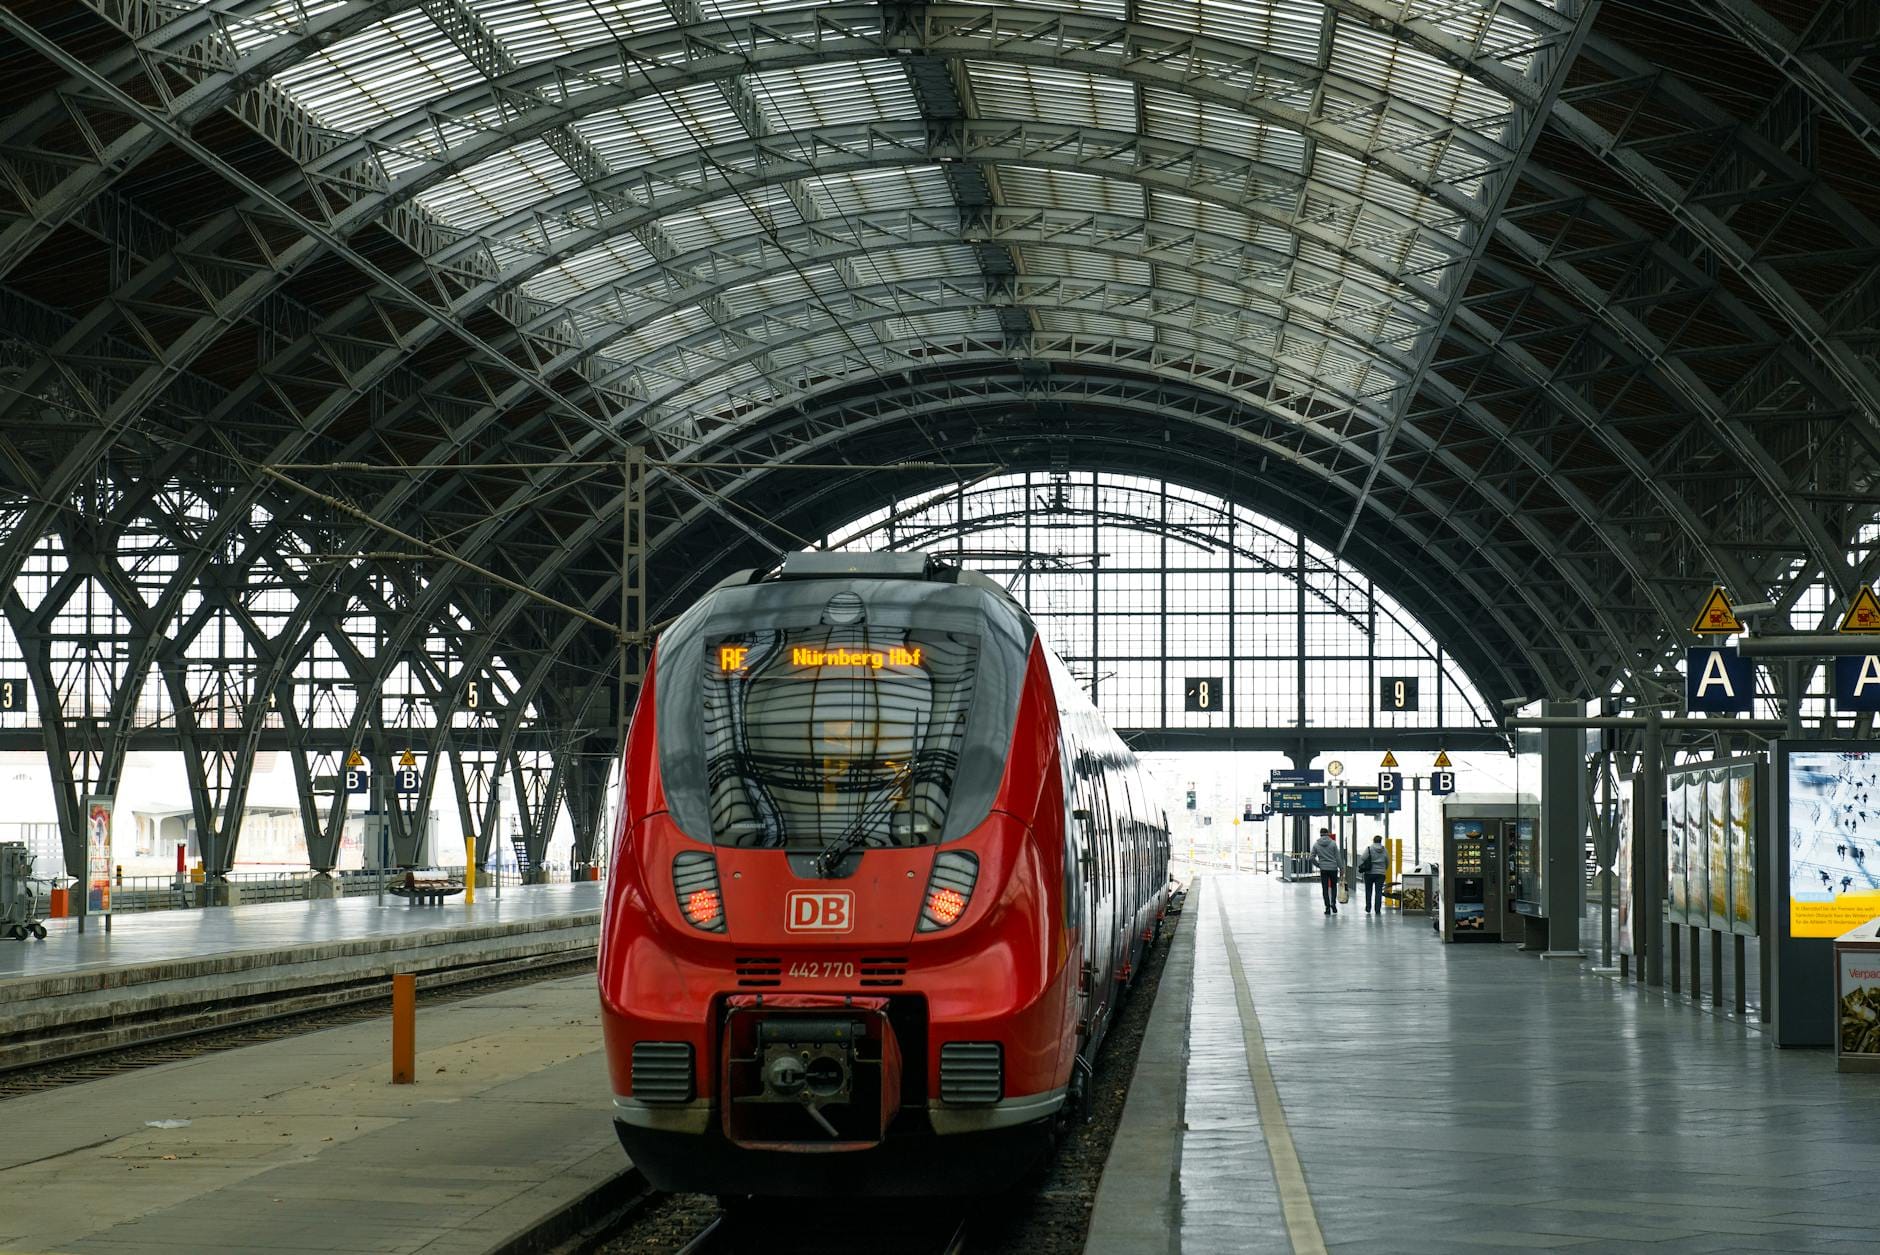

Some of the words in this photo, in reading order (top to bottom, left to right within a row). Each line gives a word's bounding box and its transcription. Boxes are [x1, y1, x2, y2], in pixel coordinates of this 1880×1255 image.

[721, 649, 748, 670] RE
[793, 648, 883, 668] Nürnberg
[889, 648, 920, 666] Hbf
[1696, 651, 1735, 697] A
[1853, 655, 1880, 696] A
[3, 682, 13, 709] 3
[468, 682, 478, 708] 5
[1199, 681, 1209, 708] 8
[1394, 680, 1405, 708] 9
[346, 771, 359, 789] B
[403, 771, 416, 789] B
[1380, 773, 1394, 791] B
[1439, 773, 1453, 791] B
[1263, 803, 1272, 815] C
[794, 897, 846, 926] DB
[788, 962, 819, 978] 442
[823, 962, 854, 978] 770
